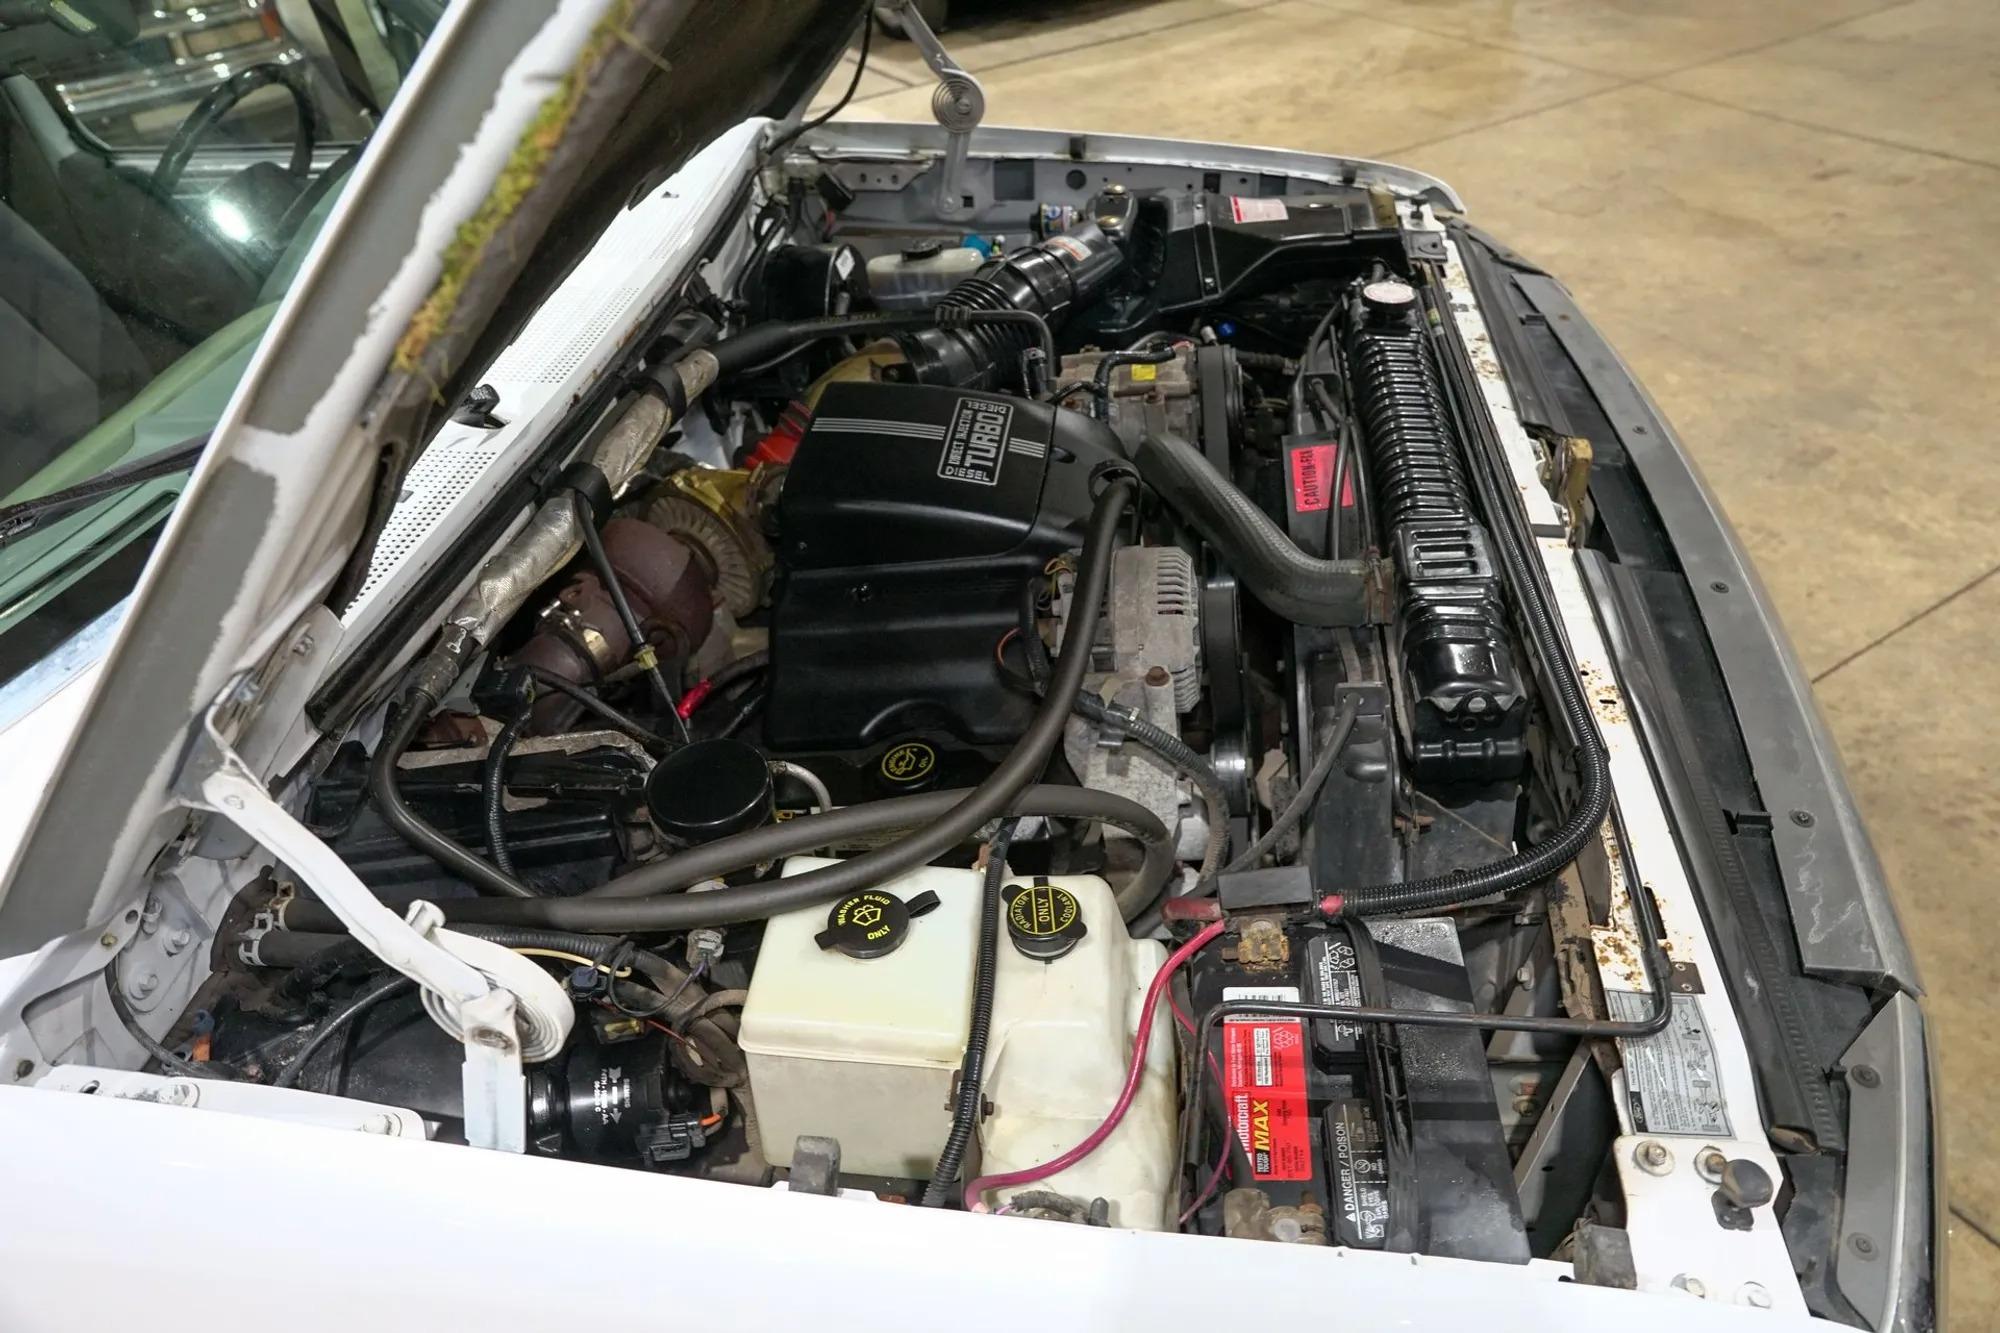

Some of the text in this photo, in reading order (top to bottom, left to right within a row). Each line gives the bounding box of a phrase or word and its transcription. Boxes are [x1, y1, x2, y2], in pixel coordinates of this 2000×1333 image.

[965, 400, 1007, 414] DIESEL
[964, 411, 1004, 467] TURBO
[945, 466, 990, 481] DIESEL
[837, 894, 891, 926] WASHER FLUID
[1013, 894, 1032, 930] RADIATOR
[1036, 897, 1050, 923] ONLY
[1056, 892, 1073, 923] COOLANT
[867, 924, 891, 940] ONLY
[1252, 1100, 1270, 1151] MAX
[1336, 1122, 1348, 1159] POISON
[1341, 1168, 1354, 1211] DANGER
